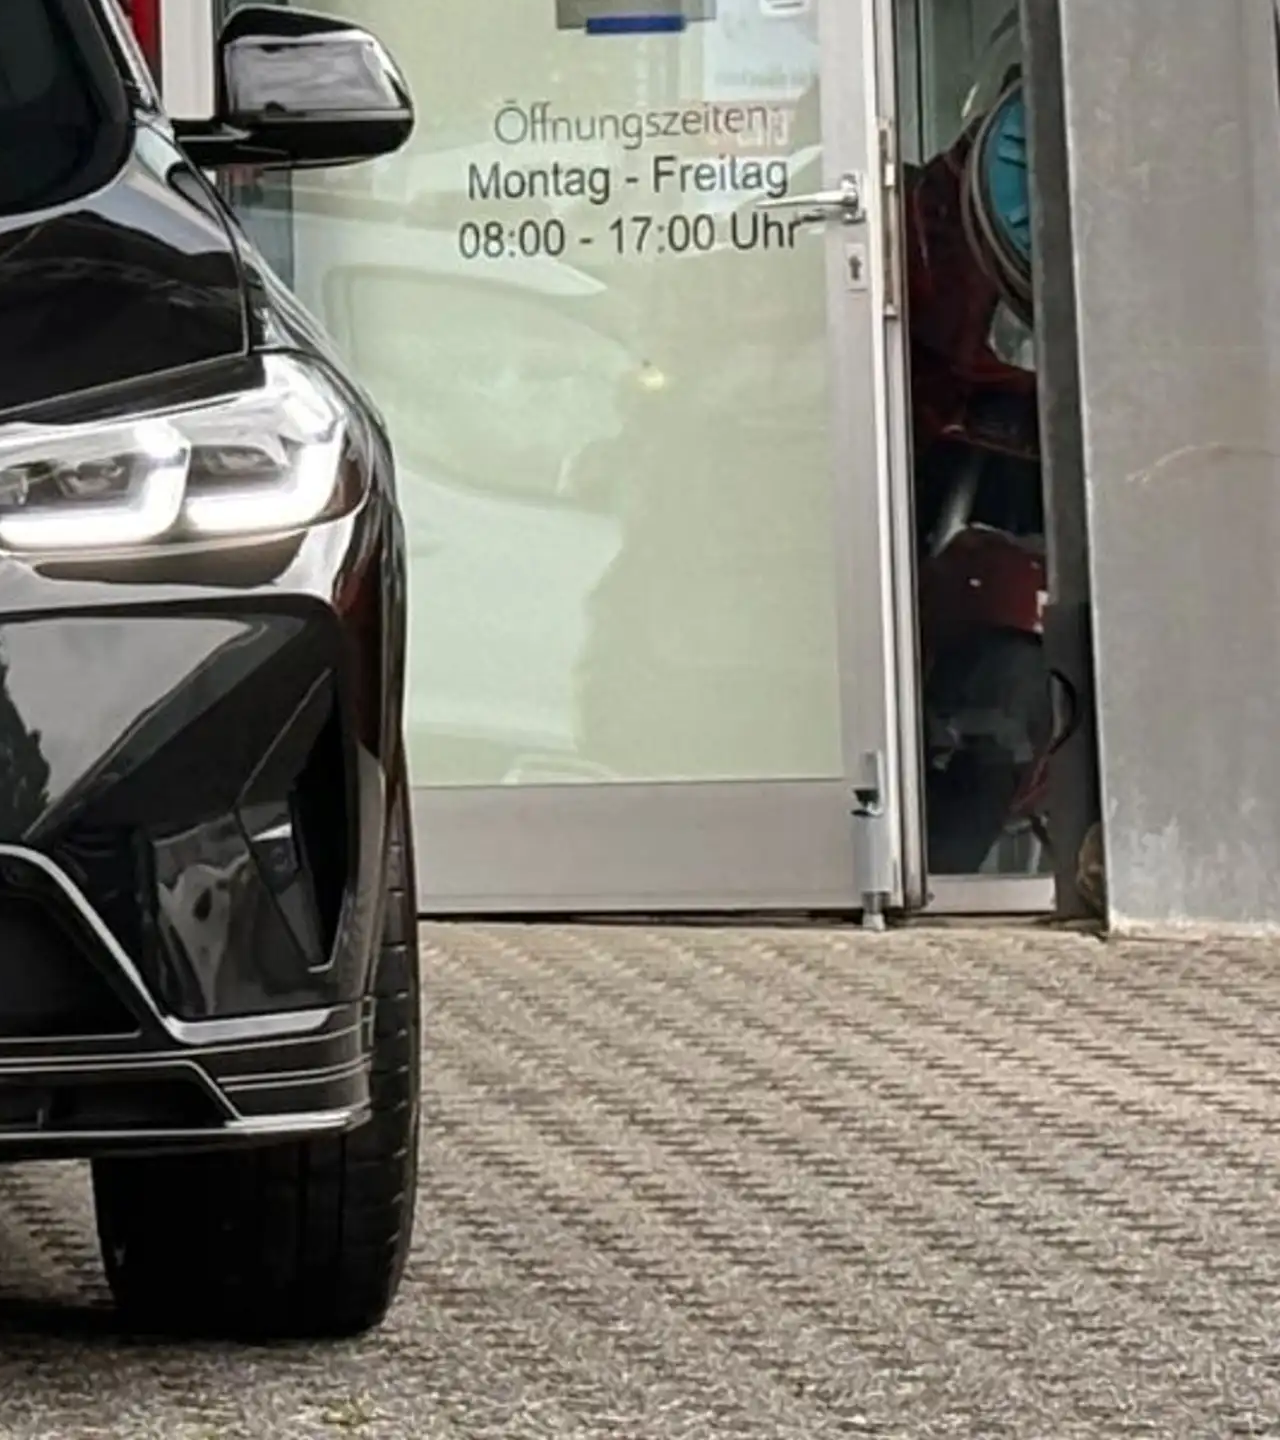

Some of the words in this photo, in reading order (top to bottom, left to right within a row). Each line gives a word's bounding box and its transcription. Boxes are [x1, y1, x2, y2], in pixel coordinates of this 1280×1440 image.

[468, 162, 610, 205] Montag
[653, 154, 788, 199] Freitag
[458, 218, 565, 260] 08:00
[608, 214, 715, 254] 17:00
[731, 211, 802, 250] Uhr
